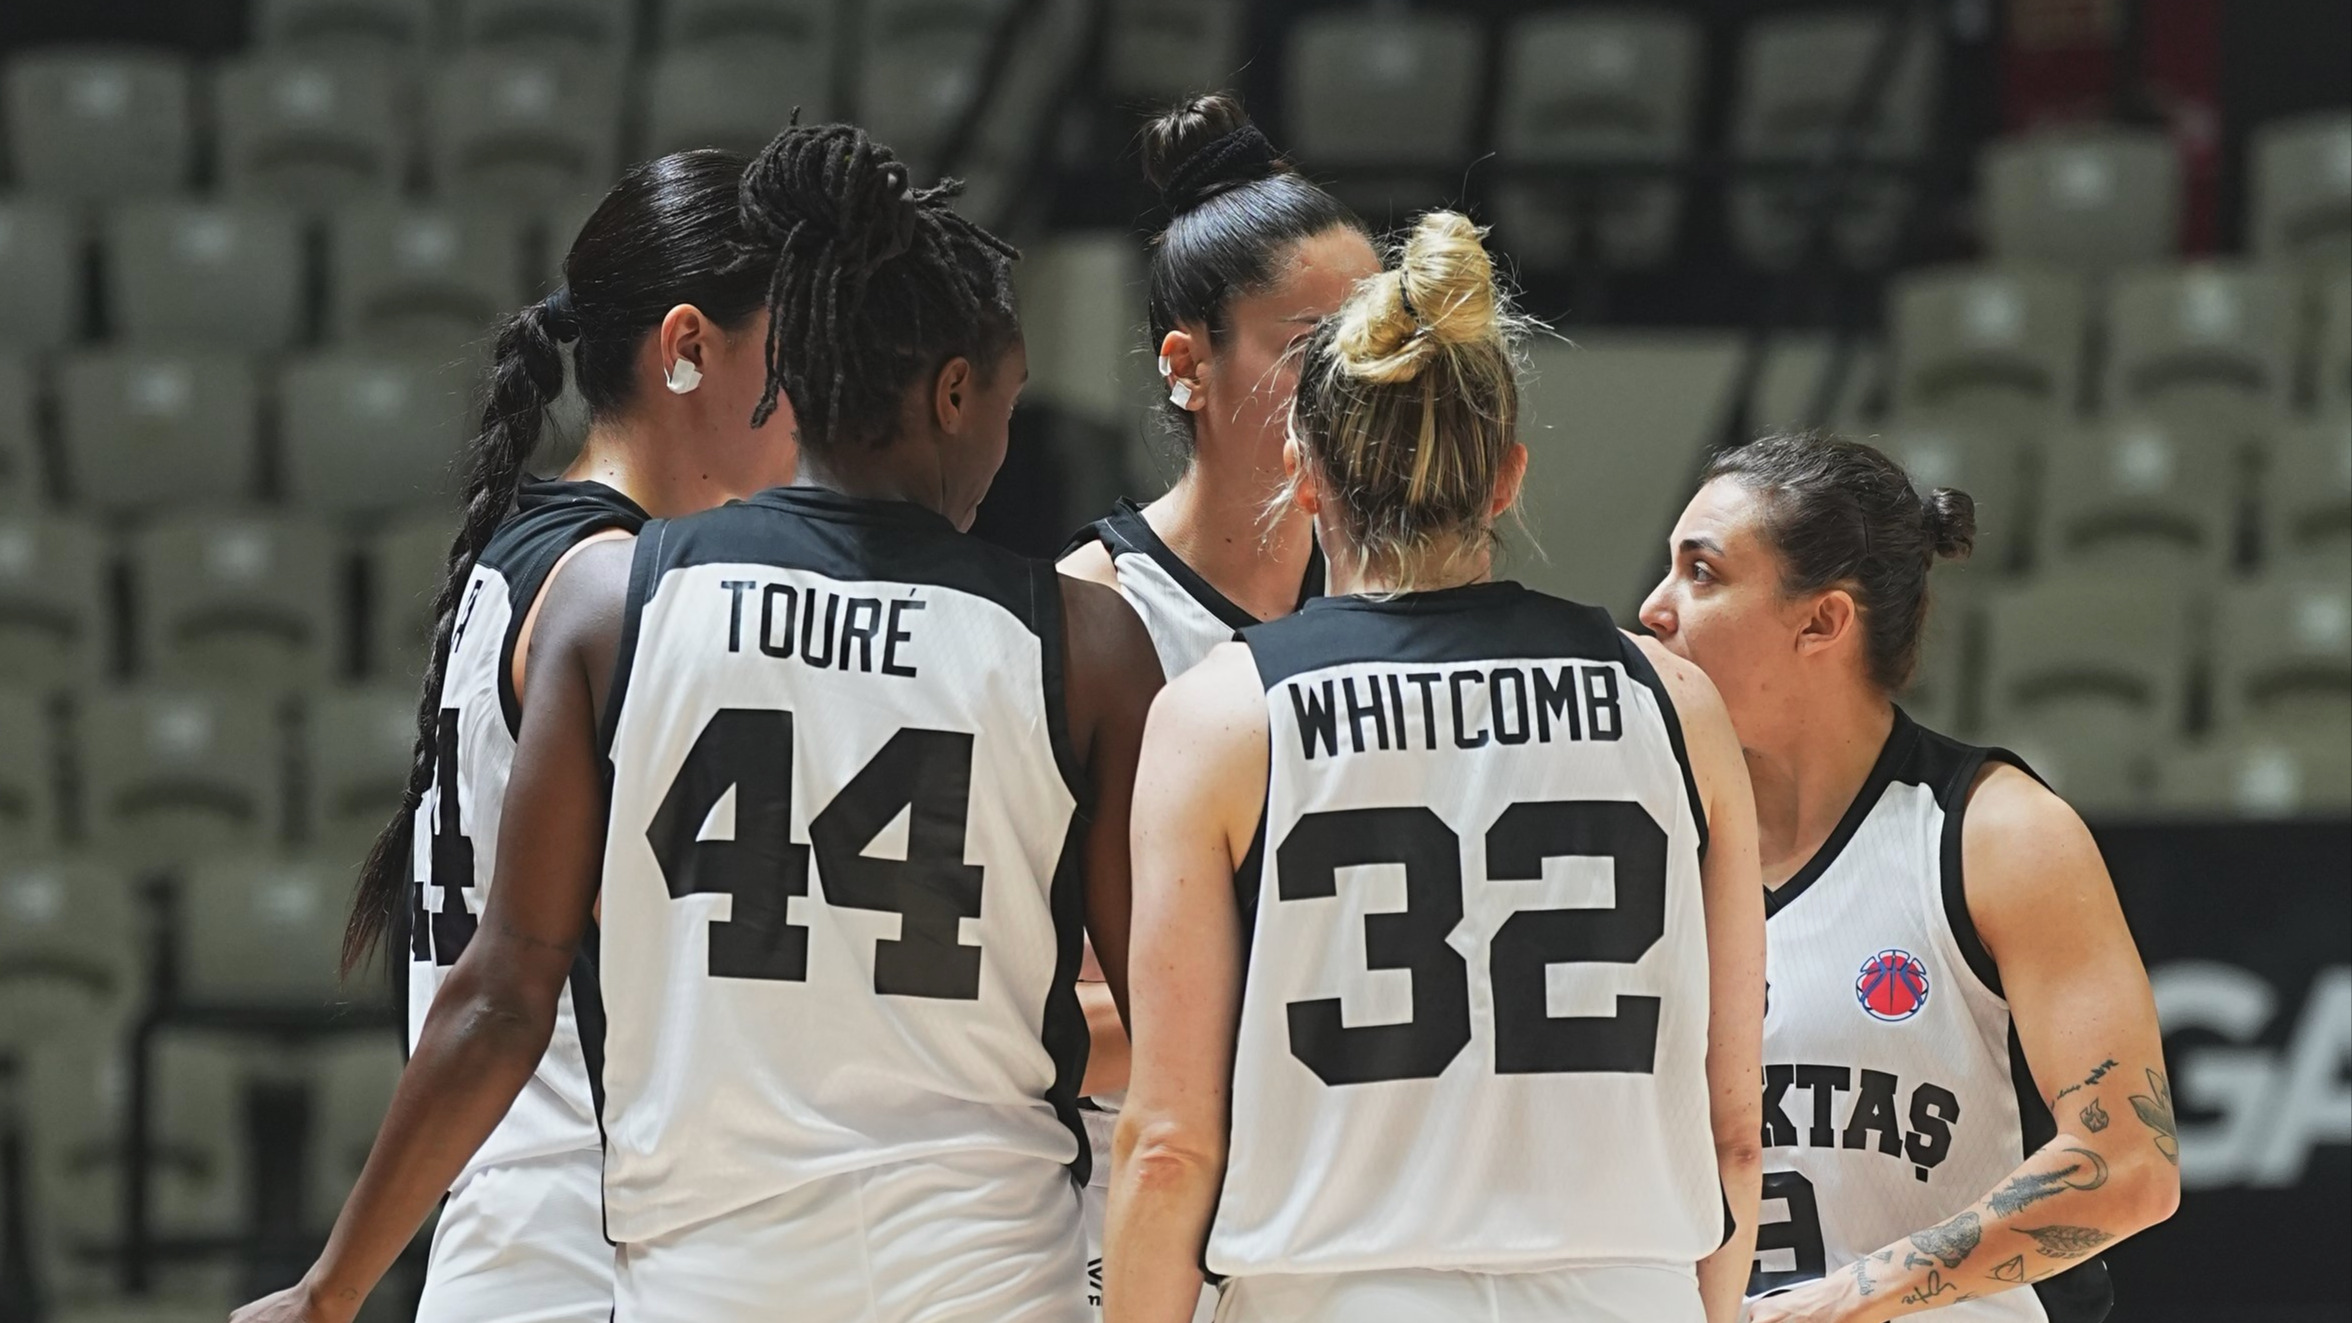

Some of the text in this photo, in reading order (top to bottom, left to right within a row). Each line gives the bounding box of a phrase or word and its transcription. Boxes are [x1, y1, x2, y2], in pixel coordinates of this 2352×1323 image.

[720, 578, 927, 678] TOURÉ
[1288, 665, 1623, 760] WHITCOMB
[411, 707, 479, 966] 4
[645, 708, 985, 1001] 44
[1276, 800, 1669, 1087] 32
[1761, 1063, 1961, 1184] KTAŞ
